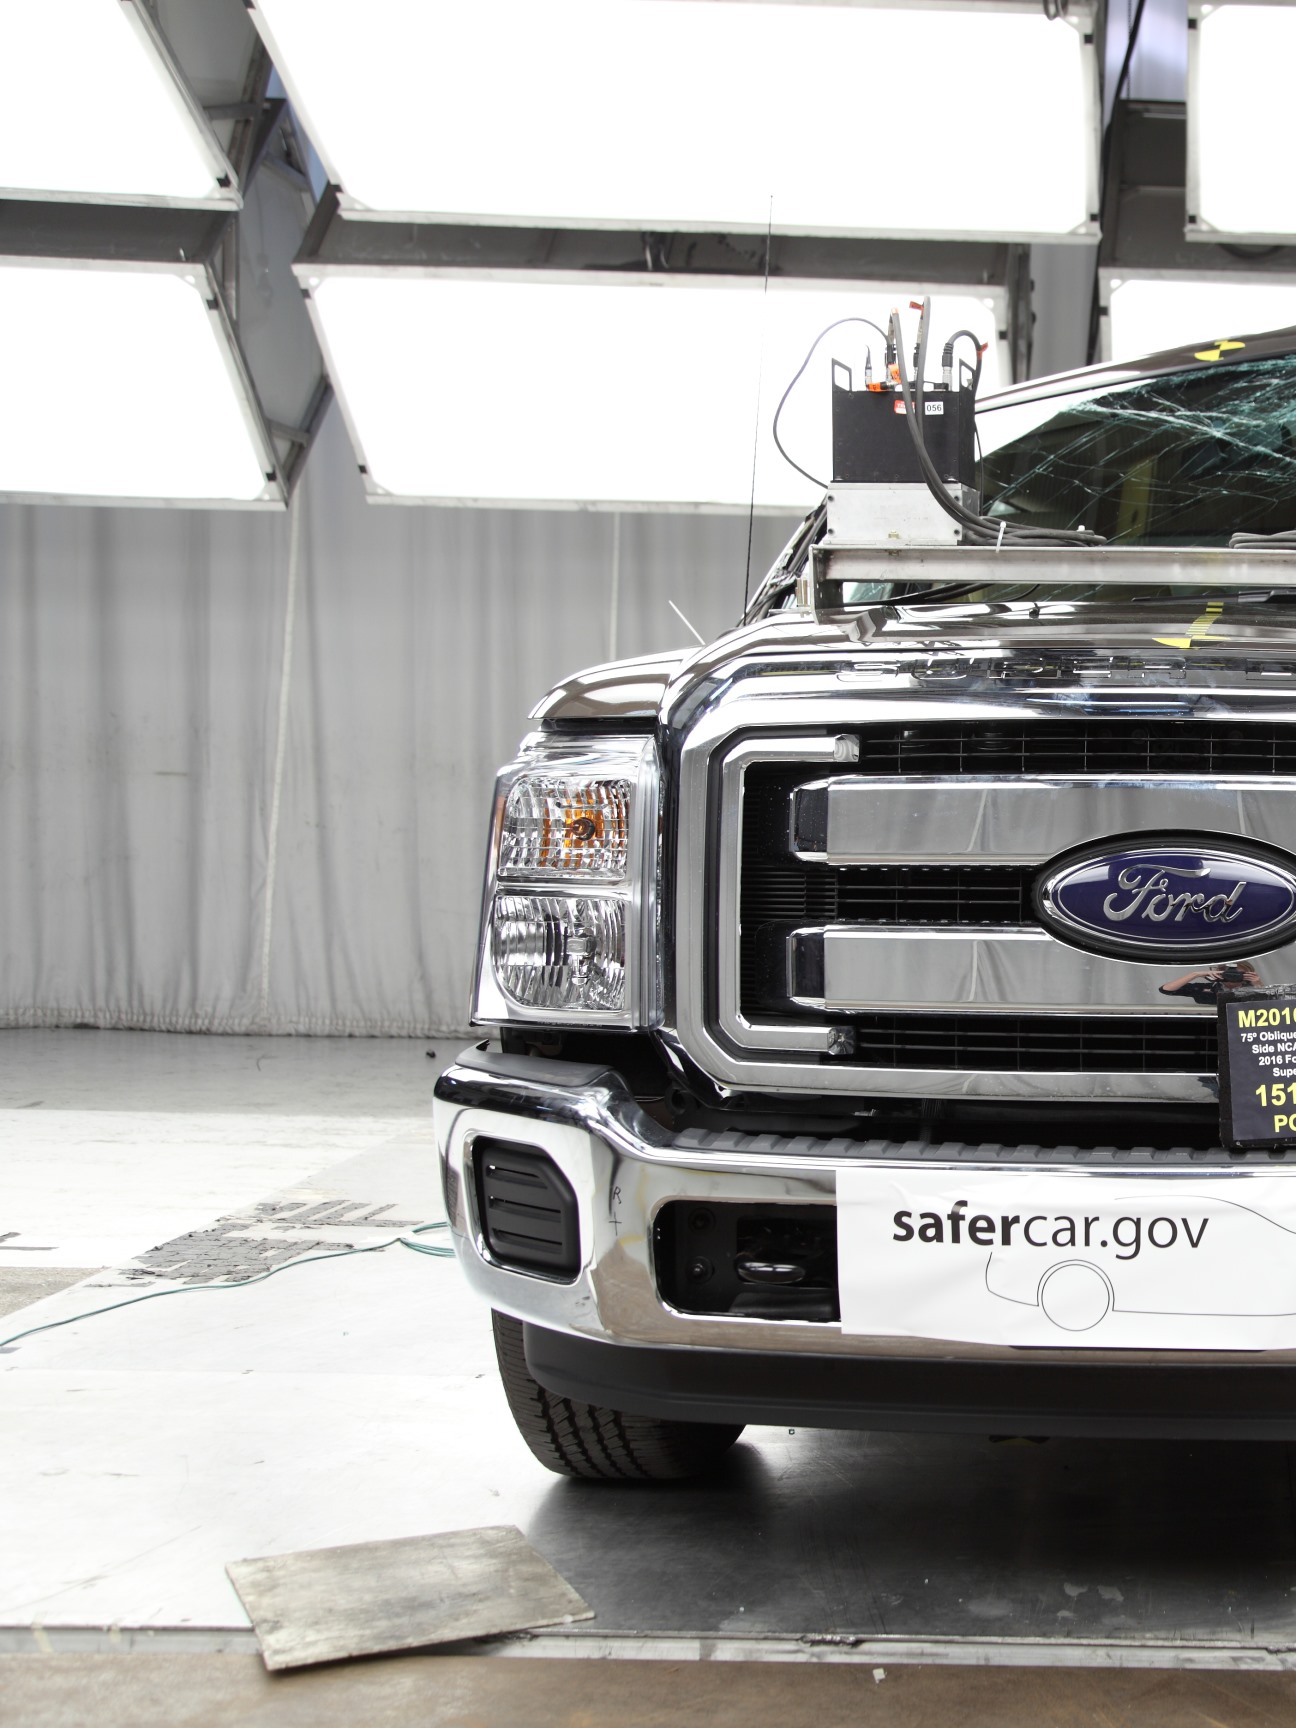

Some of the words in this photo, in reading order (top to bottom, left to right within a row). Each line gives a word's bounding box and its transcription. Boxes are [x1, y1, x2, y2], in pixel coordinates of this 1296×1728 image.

[926, 404, 943, 412] 056
[836, 656, 1186, 681] SUPER
[1102, 863, 1247, 924] Ford
[1251, 1043, 1275, 1054] Side
[1258, 1055, 1283, 1066] 2016
[892, 1200, 1210, 1261] safercar.gov
